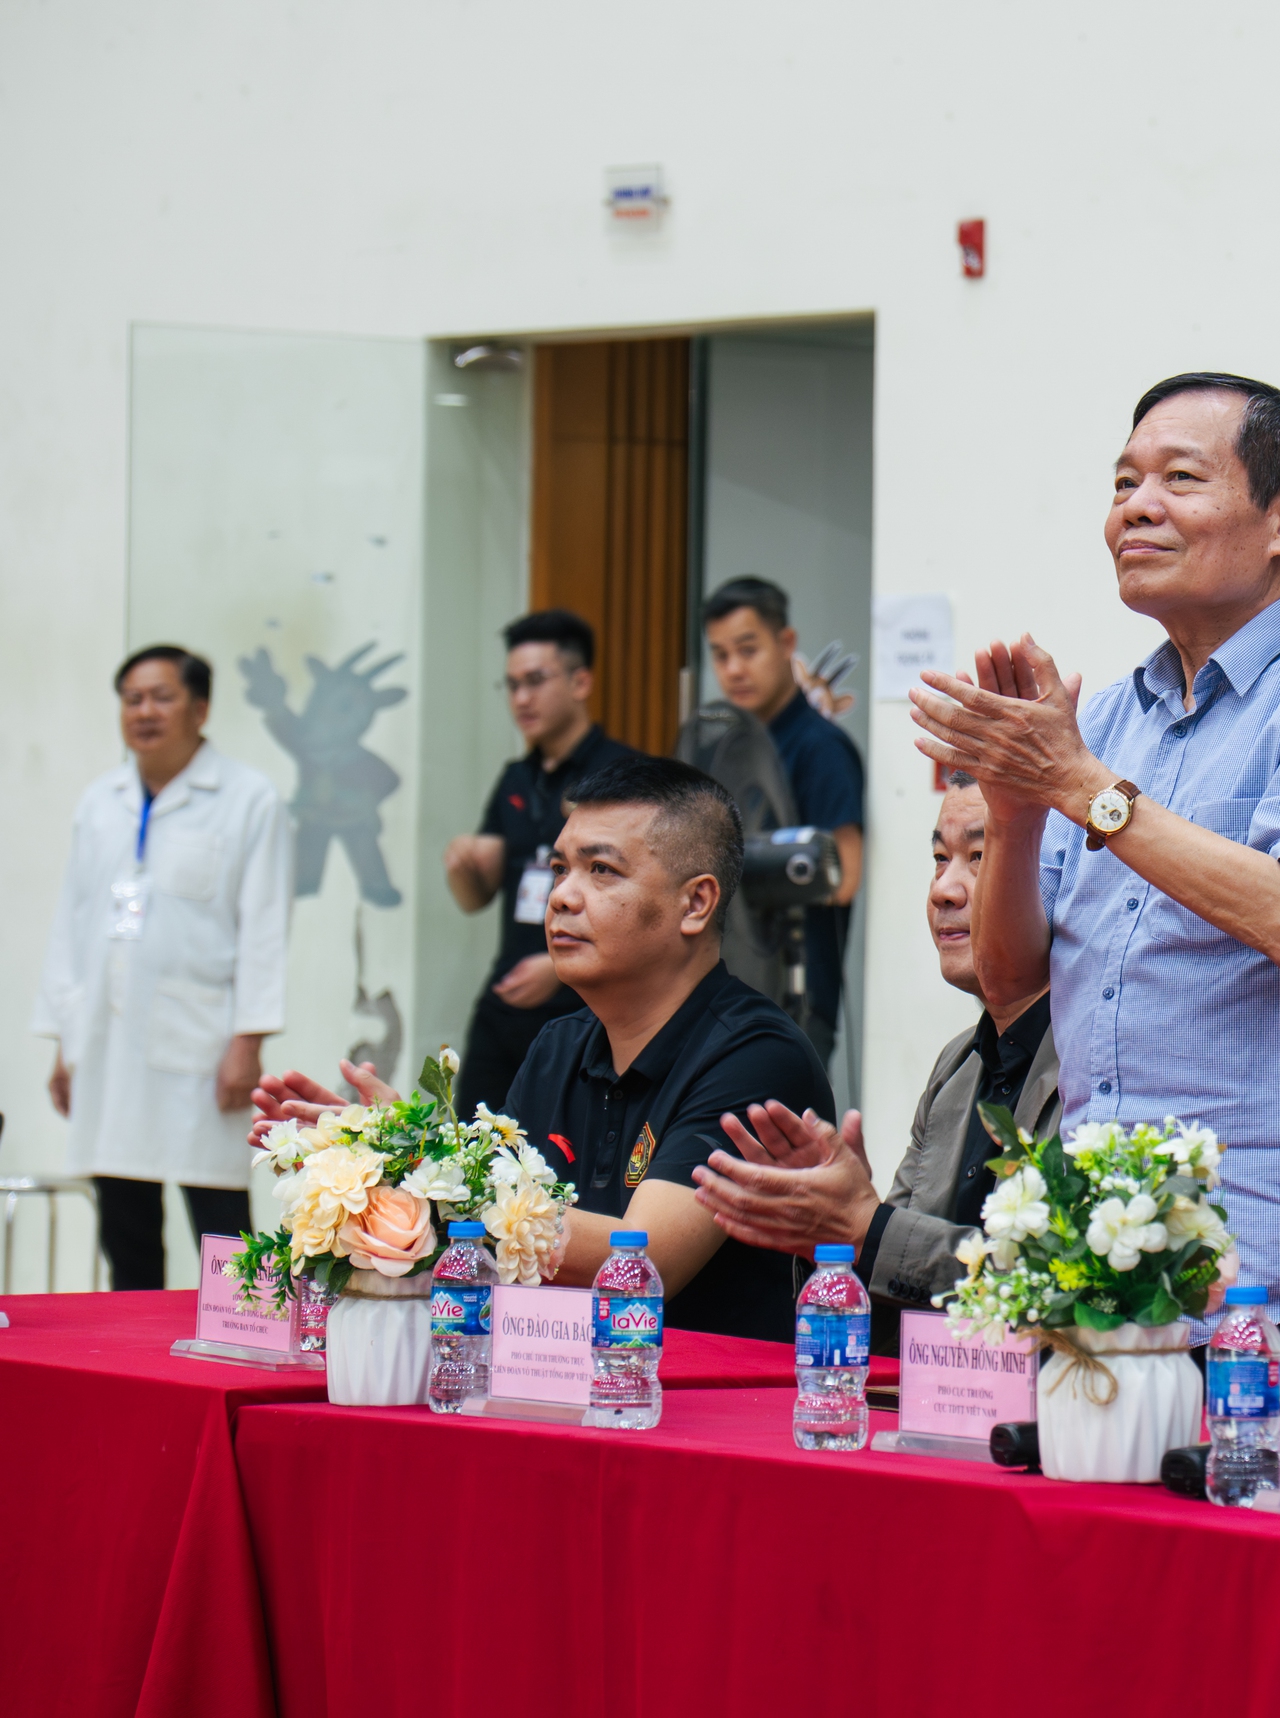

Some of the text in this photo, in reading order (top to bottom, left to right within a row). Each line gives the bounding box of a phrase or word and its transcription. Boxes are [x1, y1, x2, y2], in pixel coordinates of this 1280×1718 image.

[502, 1311, 525, 1336] ÔNG
[527, 1313, 549, 1339] ĐÀO
[551, 1320, 570, 1341] GIA
[909, 1337, 929, 1365] ÔNG
[971, 1340, 998, 1372] HỒNG
[1000, 1350, 1026, 1374] MINH
